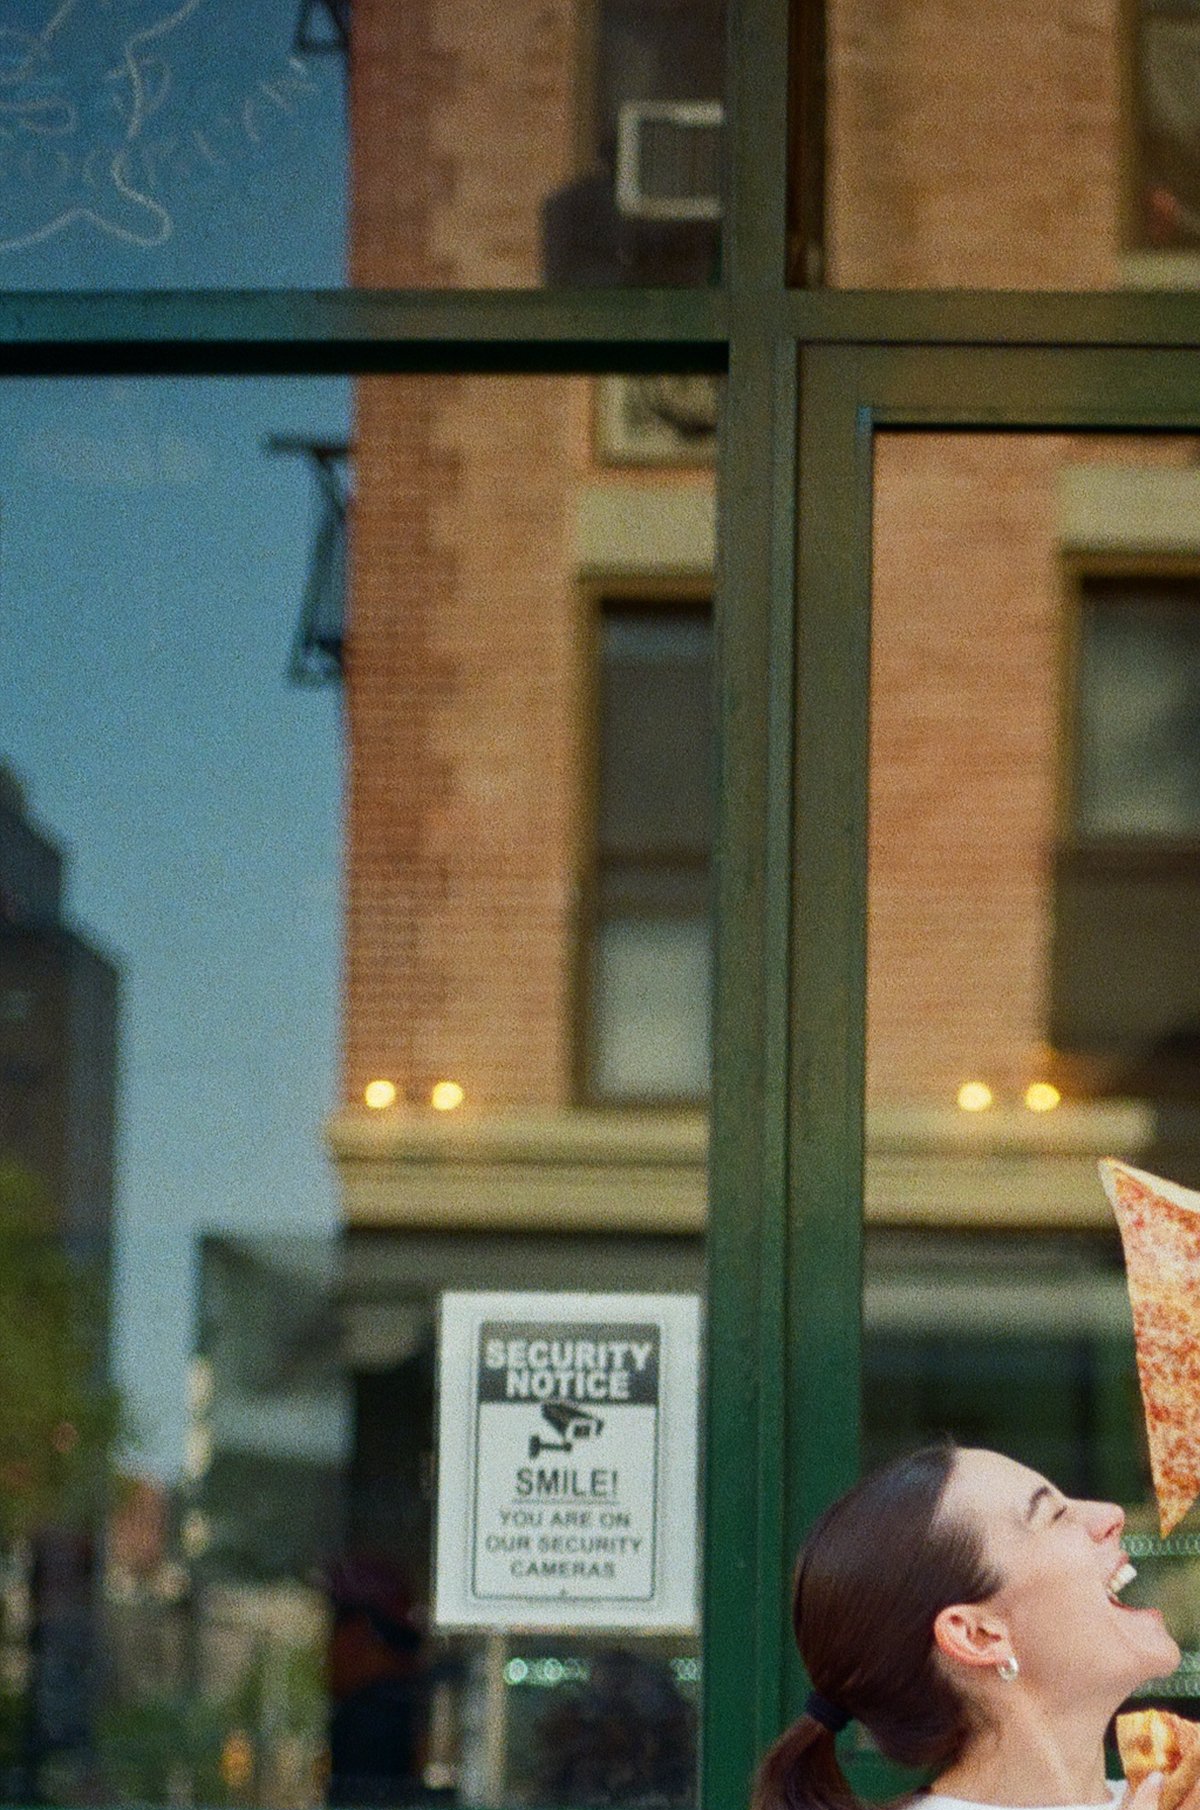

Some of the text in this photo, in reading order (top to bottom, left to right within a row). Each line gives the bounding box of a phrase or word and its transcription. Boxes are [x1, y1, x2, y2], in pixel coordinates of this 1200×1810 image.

[484, 1339, 652, 1370] SECURITY
[506, 1370, 630, 1398] NOTICE
[515, 1467, 618, 1498] SMILE!
[501, 1510, 631, 1528] YOU ARE ON
[486, 1534, 643, 1555] OUR SECURITY
[510, 1560, 616, 1579] CAMERAS
